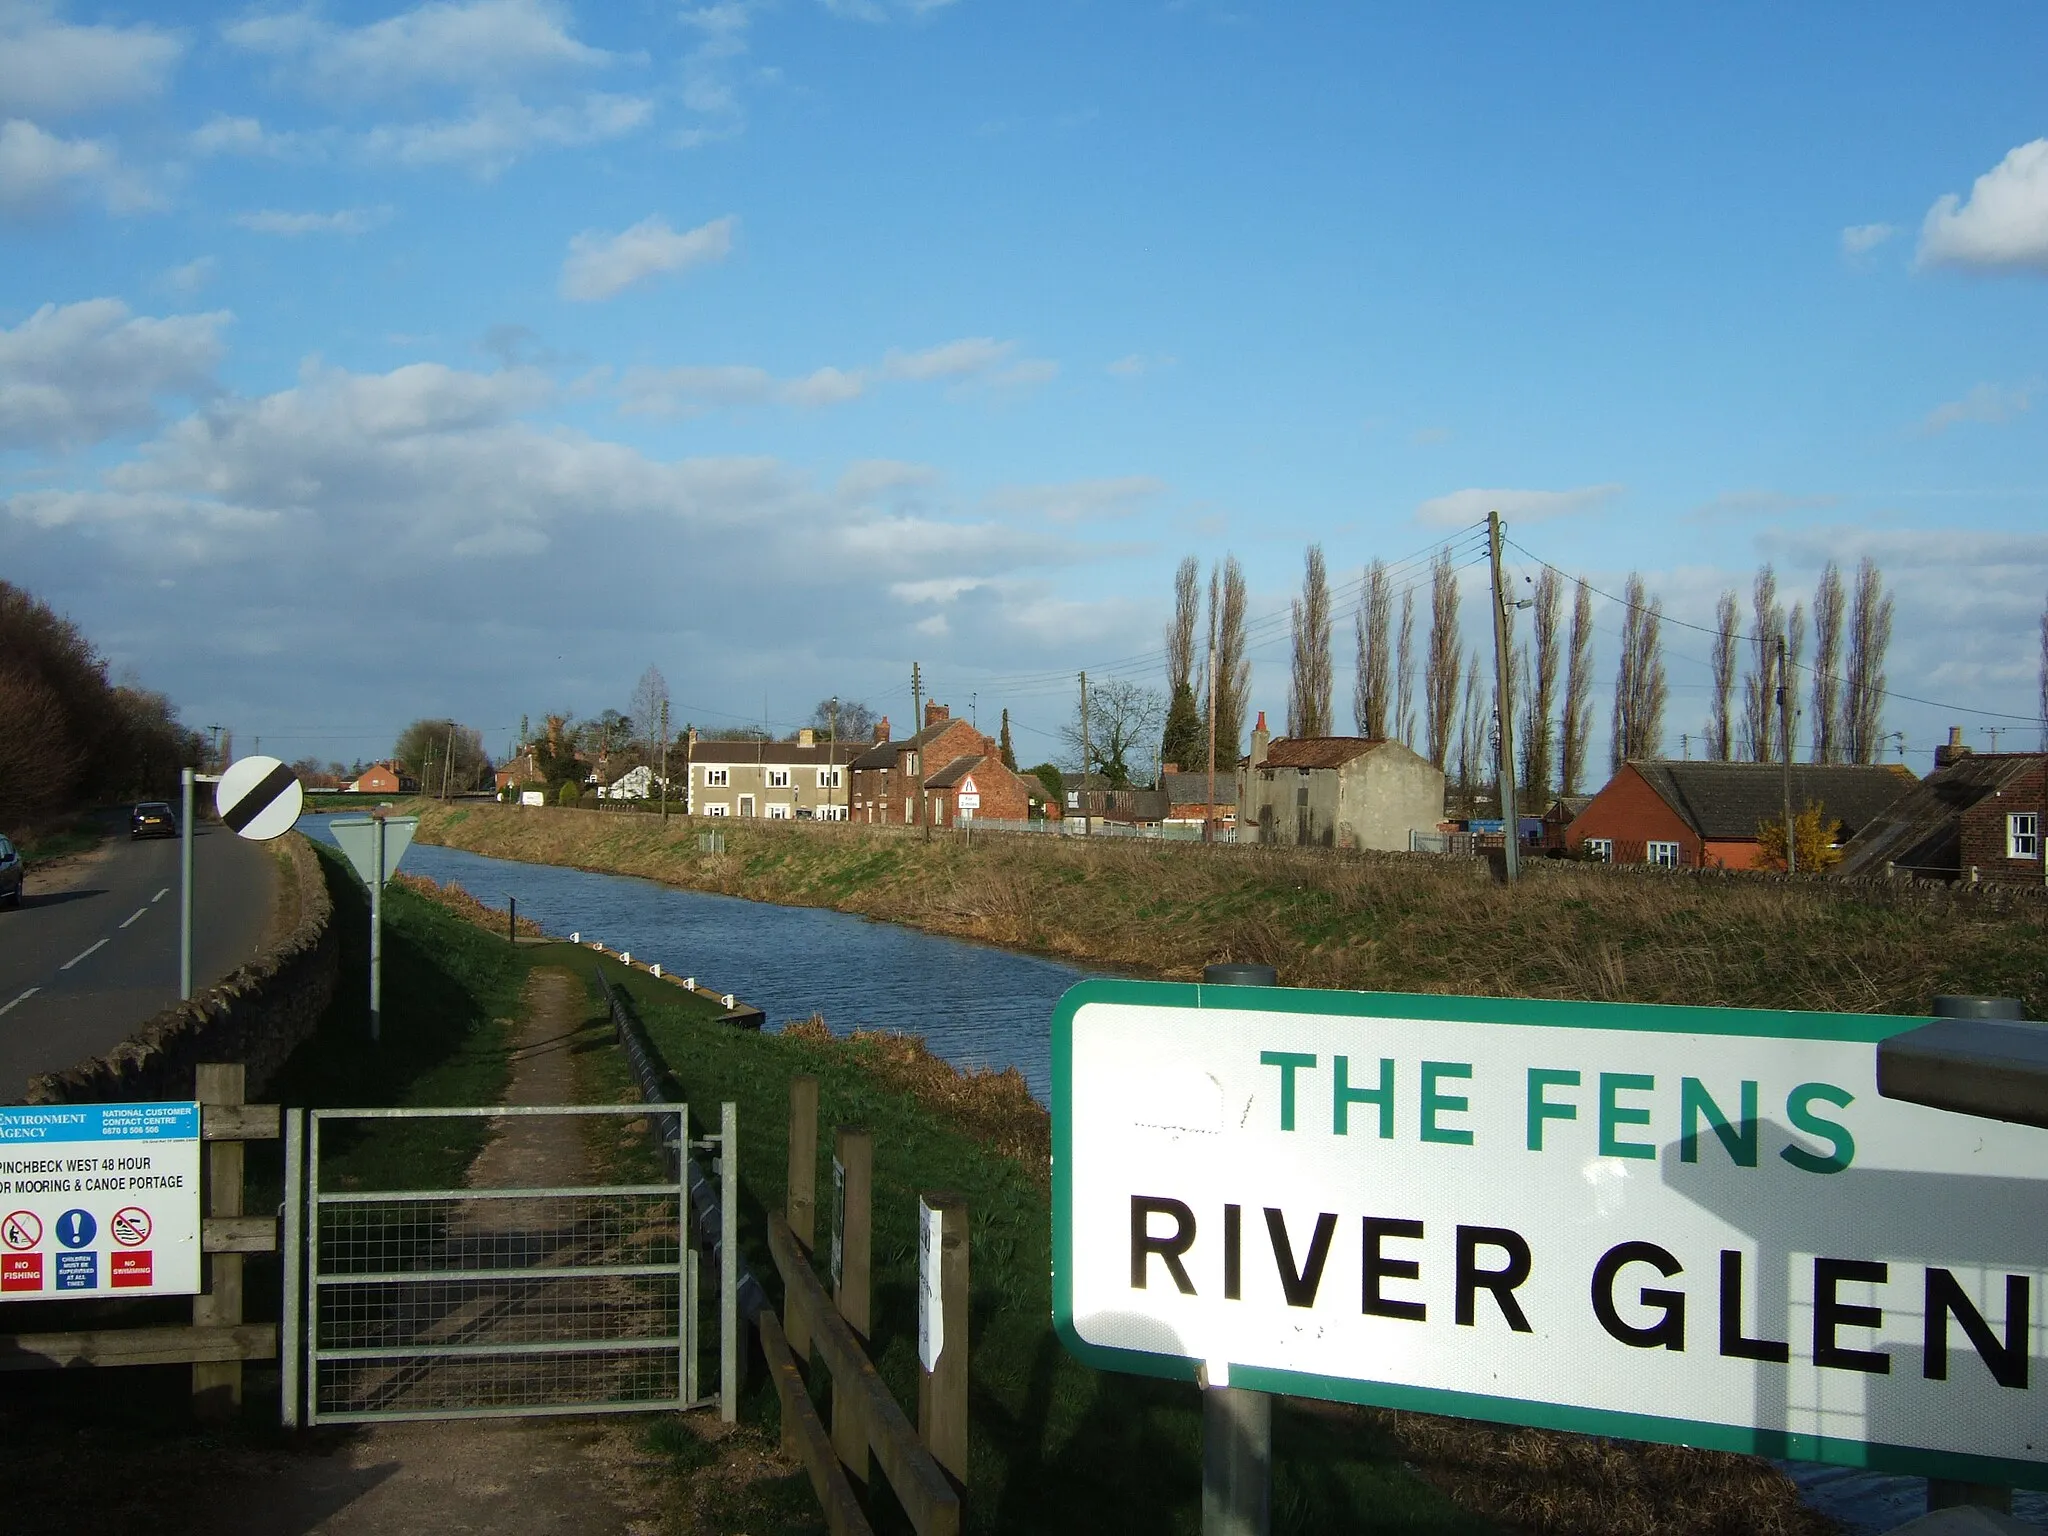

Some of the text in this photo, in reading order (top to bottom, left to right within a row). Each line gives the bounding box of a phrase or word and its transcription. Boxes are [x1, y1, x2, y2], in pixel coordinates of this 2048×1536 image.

[102, 1107, 192, 1118] NATIONAL CUSTOMER
[1260, 1050, 1856, 1175] THE FENS
[102, 1116, 177, 1126] CONTACT CENTRE
[66, 1158, 99, 1172] WEST
[101, 1158, 115, 1171] 48
[118, 1157, 151, 1170] HOUR
[15, 1180, 70, 1194] MOORING
[74, 1179, 82, 1192] &
[85, 1177, 126, 1191] CANOE
[129, 1175, 183, 1190] PORTAGE
[15, 1261, 29, 1269] NO
[4, 1271, 40, 1280] FISHING
[112, 1267, 151, 1275] SWIMMING
[1129, 1194, 2030, 1390] RIVER GLEN
